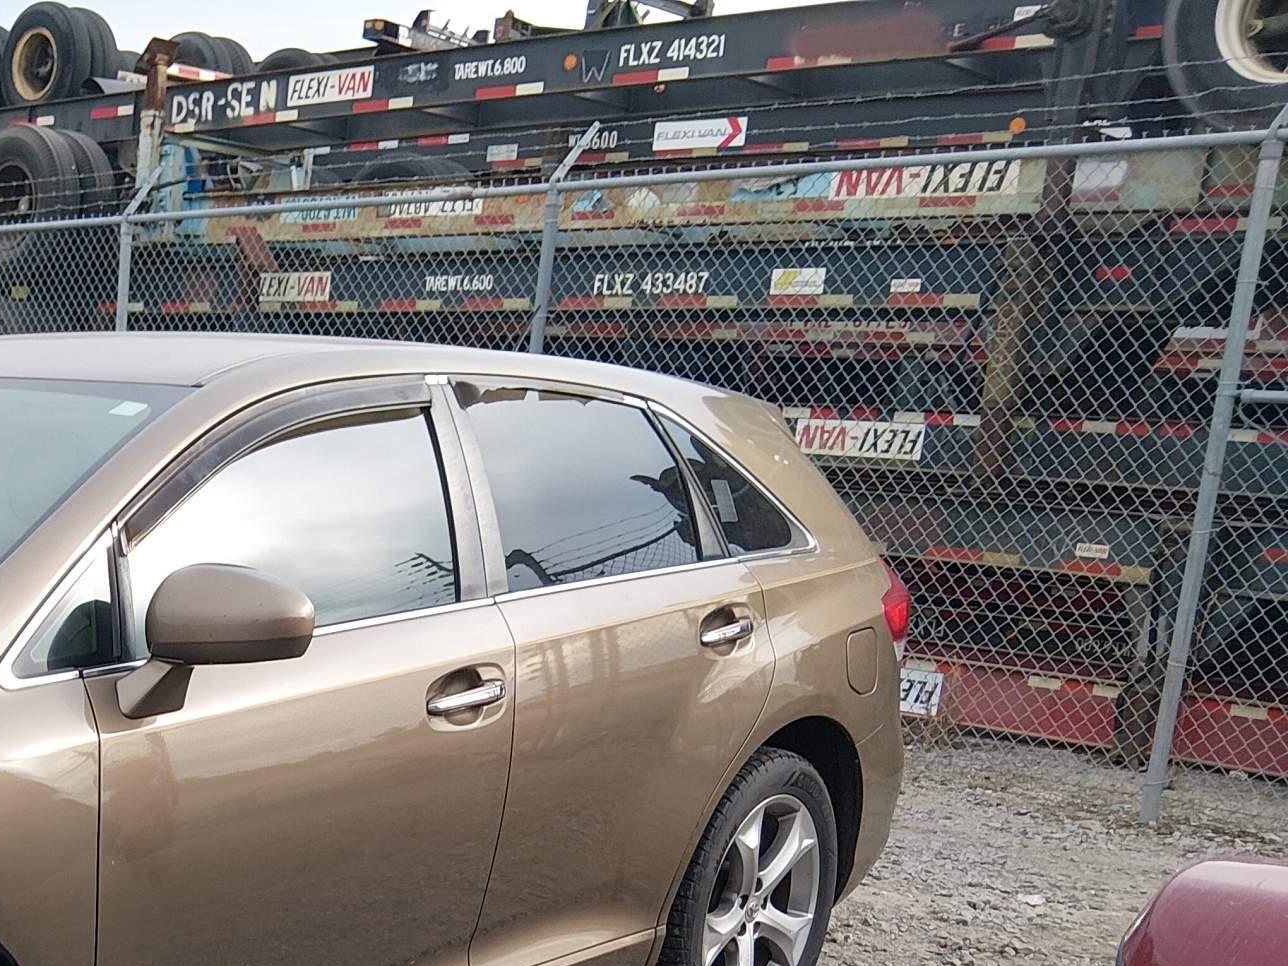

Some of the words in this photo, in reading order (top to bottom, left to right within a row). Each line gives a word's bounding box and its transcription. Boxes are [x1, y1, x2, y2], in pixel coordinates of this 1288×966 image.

[619, 41, 662, 67] FLXZ
[666, 34, 725, 62] 414321
[291, 71, 371, 101] FLEXI-VAN
[259, 275, 329, 298] LEXI-VAN
[594, 273, 632, 296] FLXZ
[640, 271, 710, 294] 433487
[799, 424, 923, 456] FLEXI-VAN
